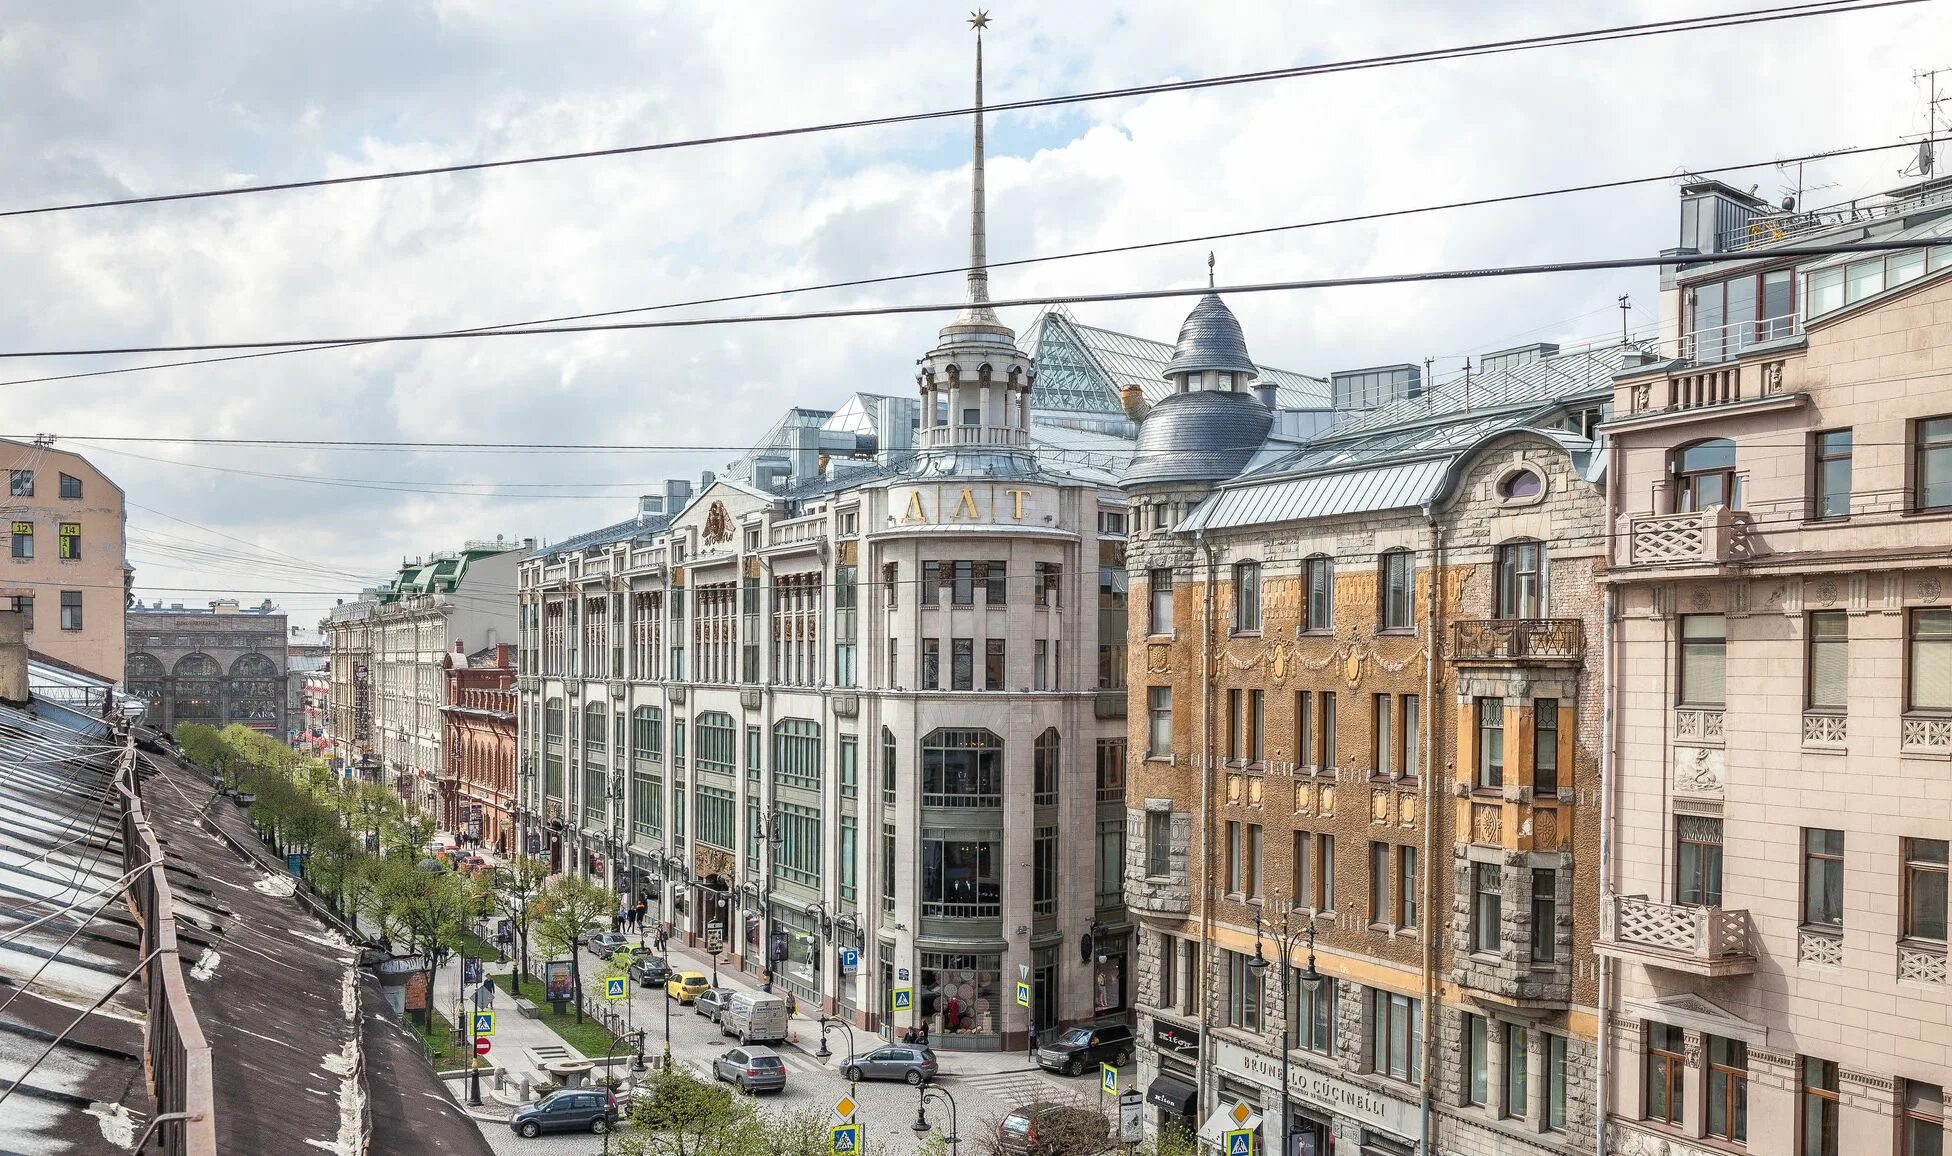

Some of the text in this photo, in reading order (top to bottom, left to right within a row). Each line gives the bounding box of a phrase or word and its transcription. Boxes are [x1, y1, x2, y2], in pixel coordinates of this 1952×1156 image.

[17, 524, 28, 533] 12
[64, 526, 76, 534] 14
[135, 690, 161, 698] ZARA
[846, 952, 856, 965] P
[1244, 1056, 1308, 1089] BRUNELO
[1313, 1080, 1386, 1117] CUCINELLI
